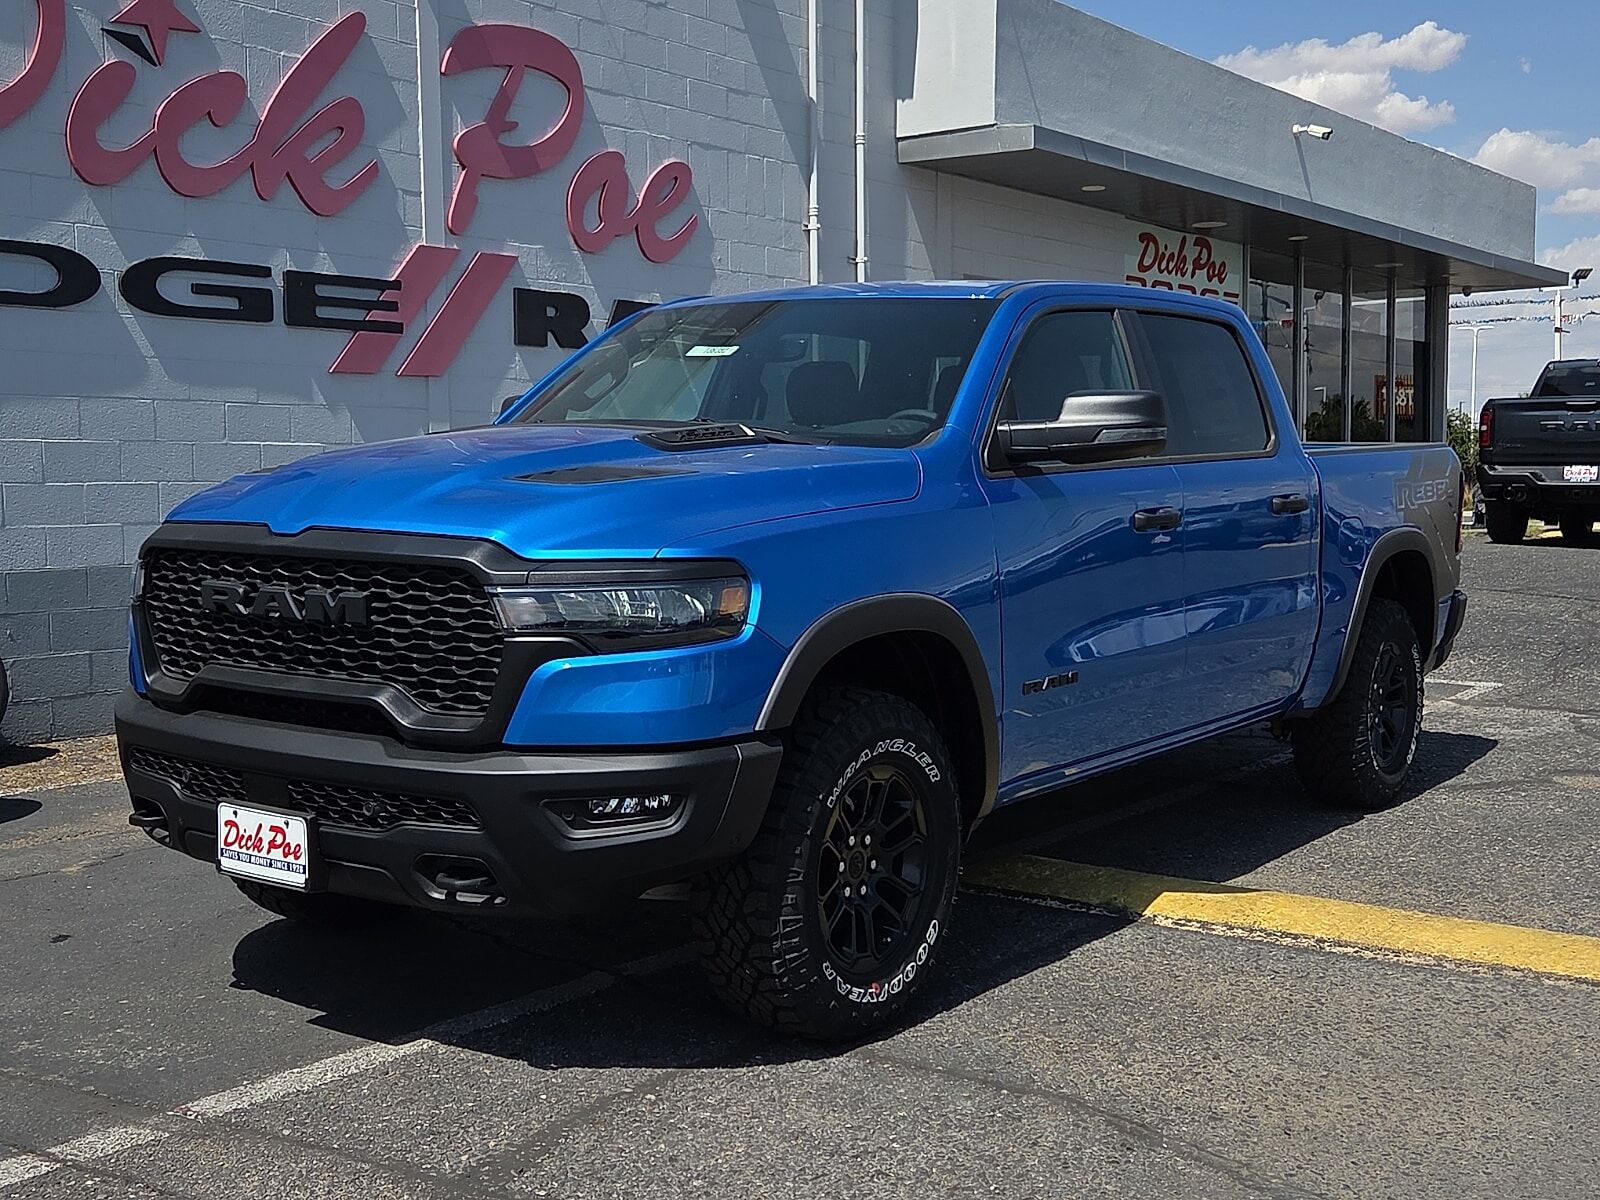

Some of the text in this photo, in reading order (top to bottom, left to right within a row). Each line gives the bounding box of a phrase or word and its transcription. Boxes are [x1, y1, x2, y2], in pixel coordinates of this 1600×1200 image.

[441, 24, 699, 263] Poe
[1137, 232, 1228, 285] Dick Poe
[201, 579, 370, 625] RAM
[1022, 670, 1079, 696] RAM
[827, 738, 940, 808] WRANGLER
[222, 848, 304, 874] SAVES YOU MONEY SINCE 1928
[224, 819, 303, 861] Dick Poe
[822, 919, 938, 1003] GOODYEAR
